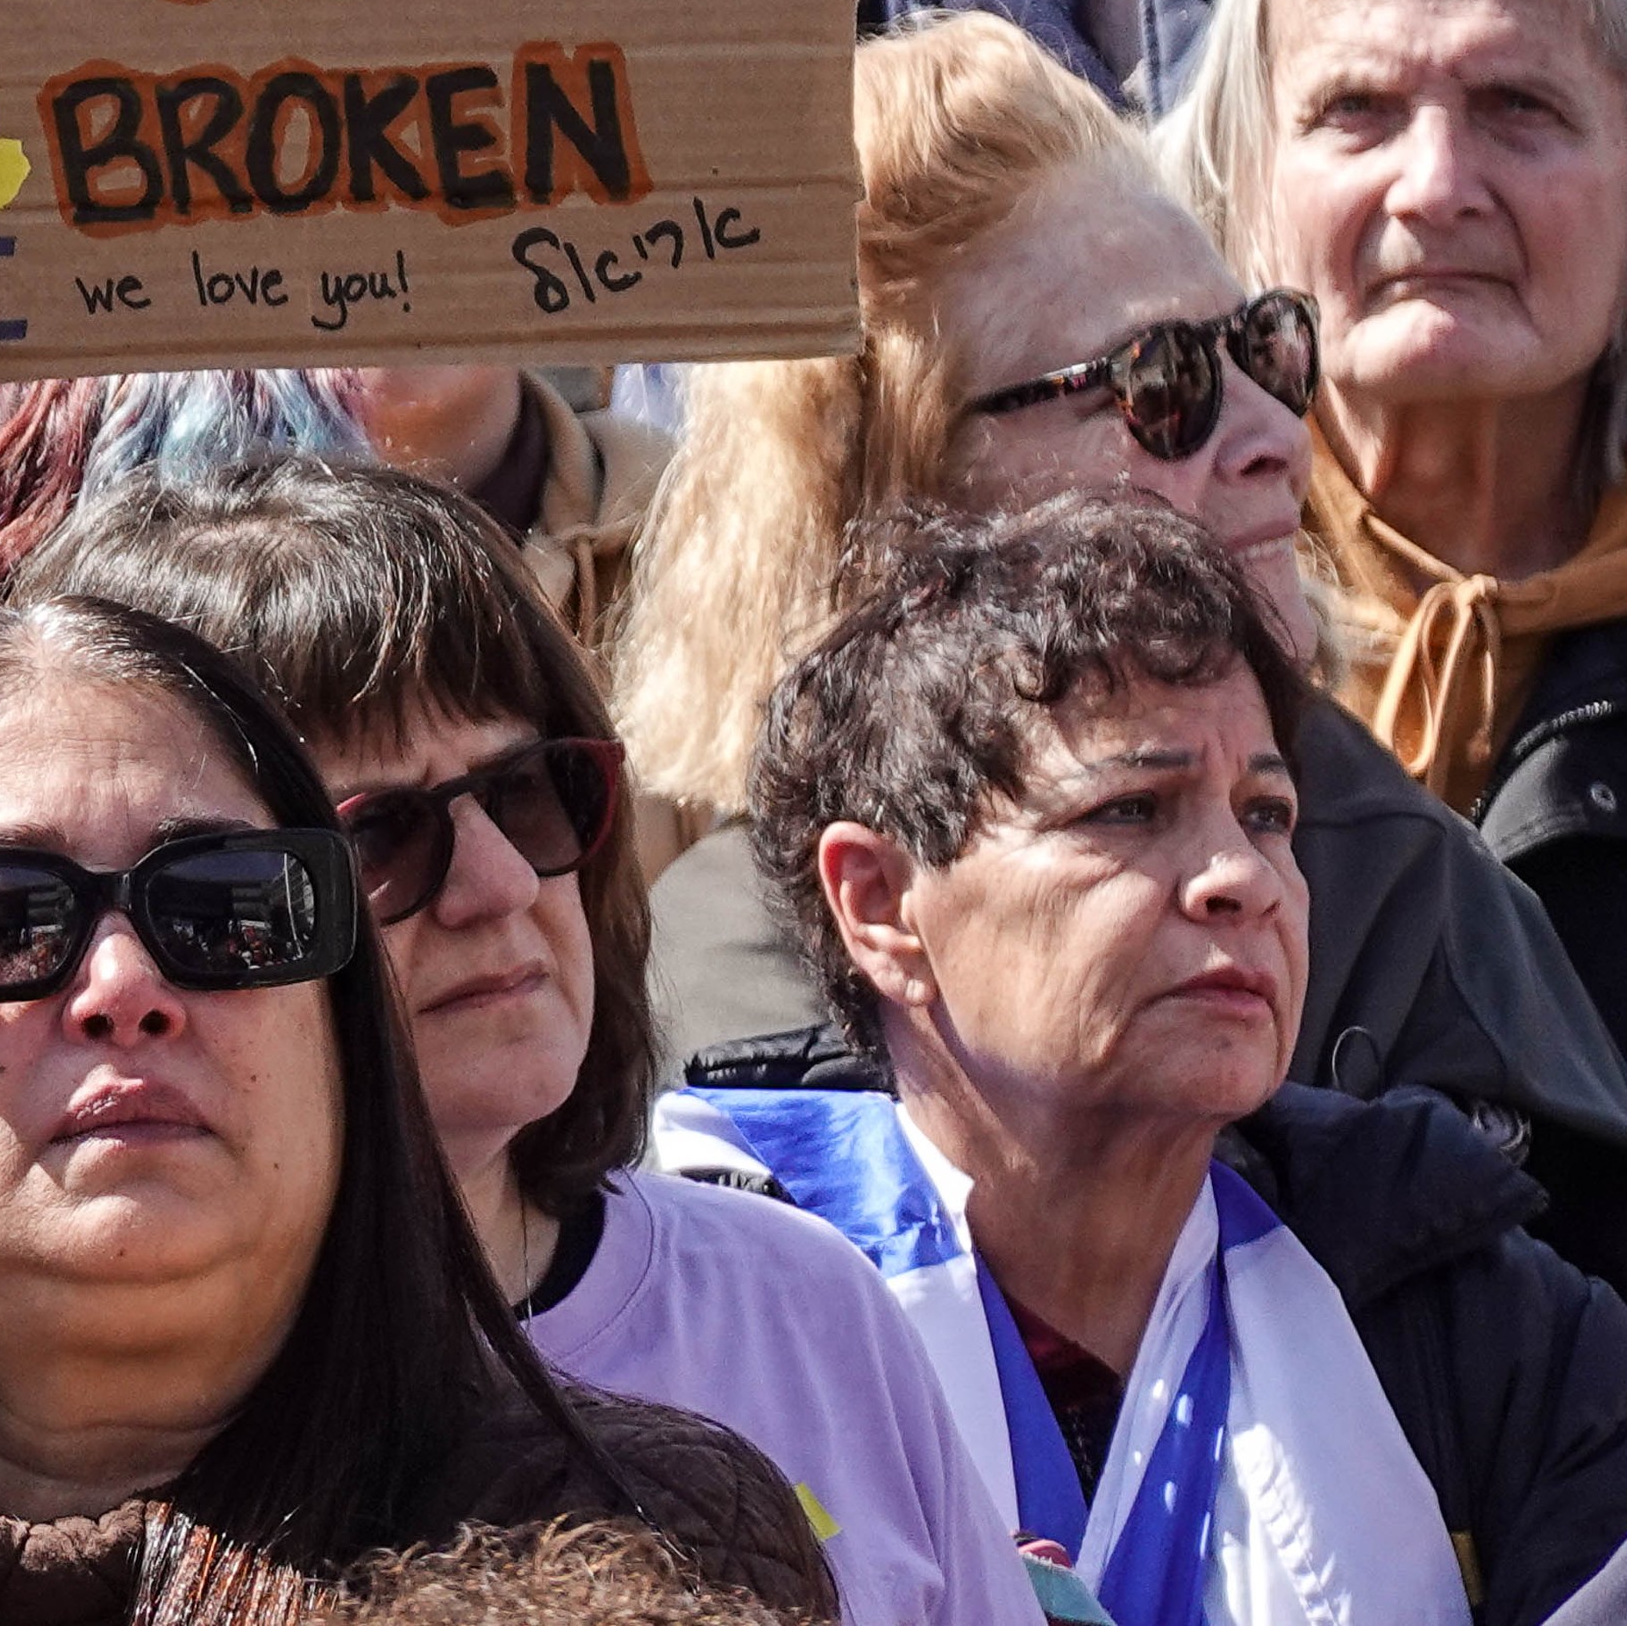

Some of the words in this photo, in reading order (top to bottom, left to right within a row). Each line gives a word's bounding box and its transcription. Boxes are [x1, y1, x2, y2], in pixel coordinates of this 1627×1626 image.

[45, 50, 642, 232] BROKEN
[75, 274, 152, 315] we
[191, 249, 289, 307] love
[311, 249, 411, 331] you!
[511, 196, 761, 314] אריאל
